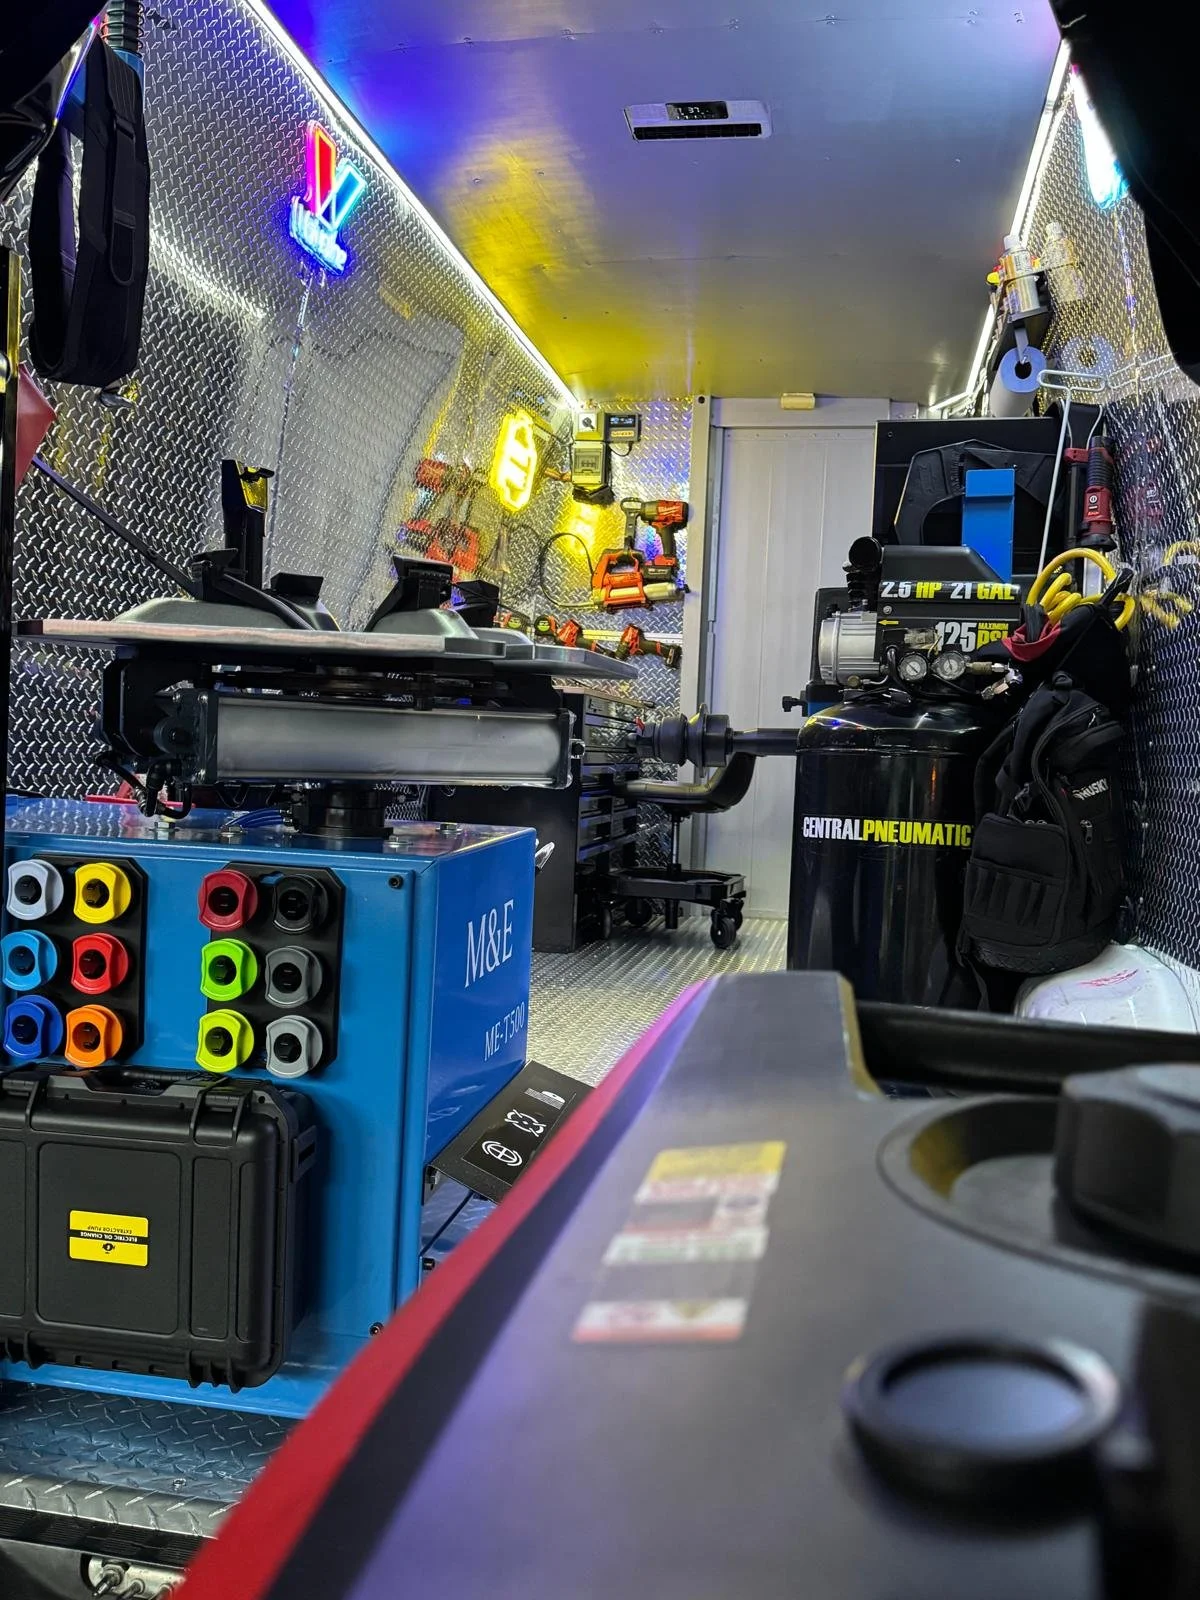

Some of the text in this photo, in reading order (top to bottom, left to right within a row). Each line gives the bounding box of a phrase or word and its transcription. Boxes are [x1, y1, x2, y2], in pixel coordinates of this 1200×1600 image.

[881, 581, 1015, 600] 2.5 HP 21 GAL
[935, 621, 977, 653] 125
[464, 899, 514, 988] M&E
[484, 1001, 525, 1062] ME-T500
[80, 1231, 103, 1239] CHANGE
[103, 1226, 132, 1234] EXTRACTOR
[113, 1234, 138, 1242] ELECTRIC
